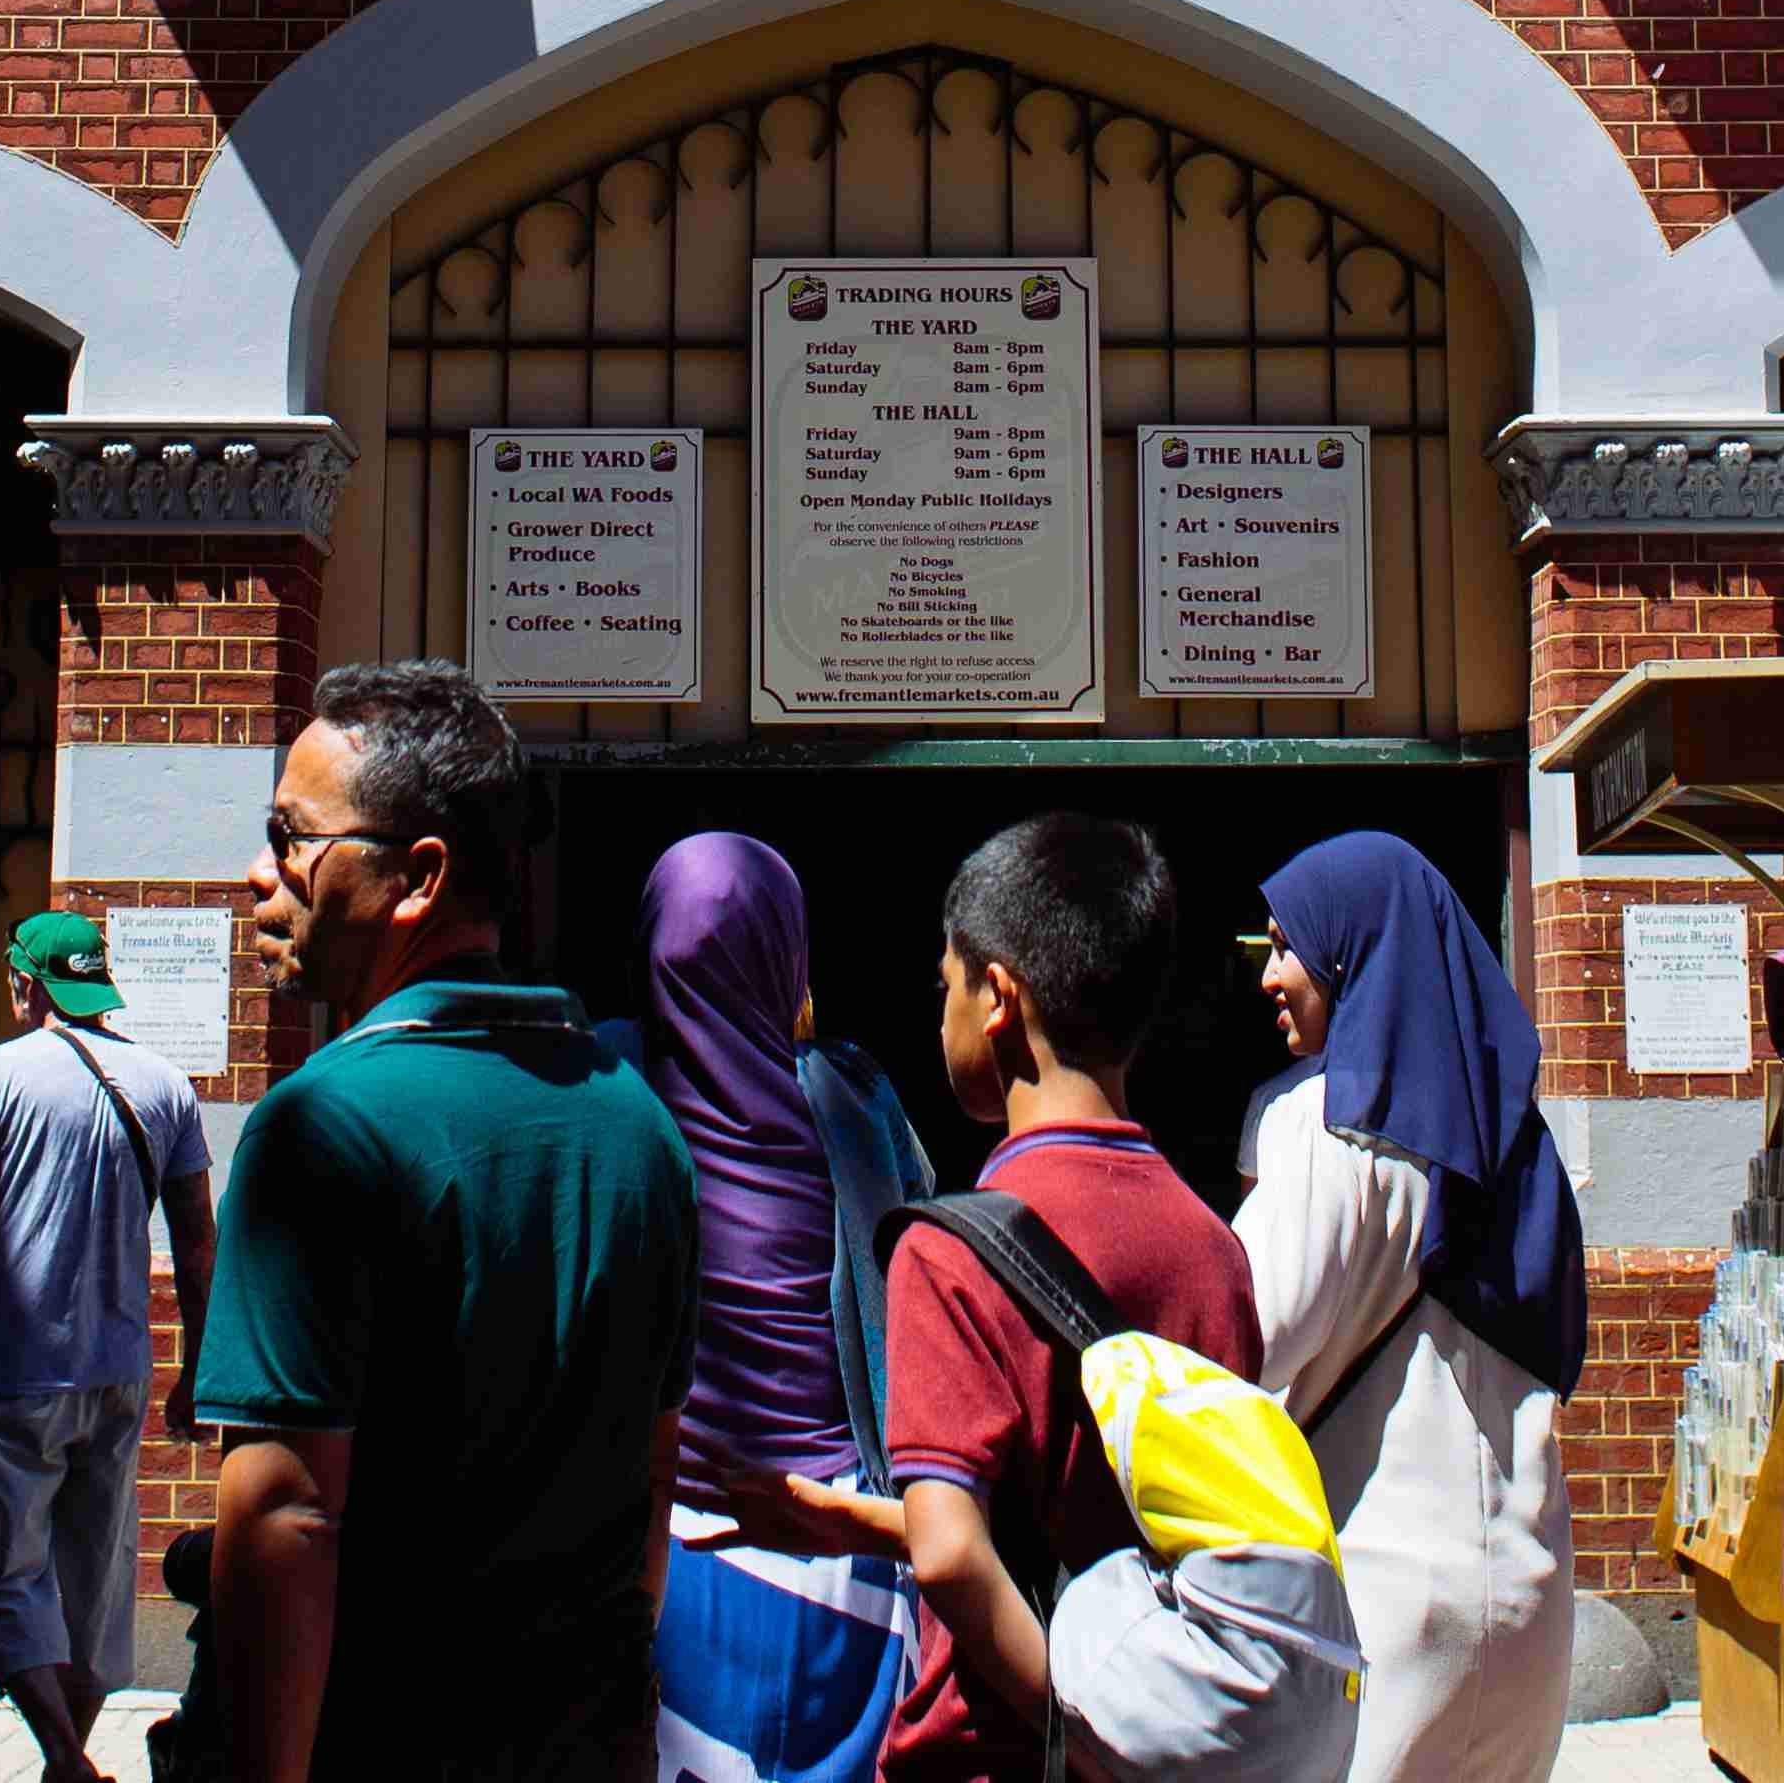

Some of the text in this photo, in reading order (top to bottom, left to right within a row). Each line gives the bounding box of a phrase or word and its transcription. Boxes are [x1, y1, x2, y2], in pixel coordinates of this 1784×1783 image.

[835, 288, 1013, 303] TRADING HOURS
[871, 320, 977, 336] THE YARD
[806, 342, 1044, 358] Friday 8am 8pm
[805, 361, 1044, 378] Saturday 8am 6pm
[805, 380, 1045, 397] Sunday 8am 6pm
[872, 405, 979, 421] THE HALL
[806, 427, 1045, 444] Friday 9am 8pm
[526, 450, 645, 468] THE YARD
[805, 446, 1046, 464] Saturday 9am 6pm
[1194, 447, 1312, 465] THE HALL
[805, 466, 1045, 483] Sunday 9am 6pm
[509, 487, 674, 503] Local WA Foods
[800, 493, 1052, 510] Open Monday Public Holidays
[1177, 483, 1283, 504] Designers
[507, 520, 654, 538] Grower Direct
[814, 520, 1040, 533] For the convenience of others PLEASE
[1176, 518, 1340, 534] Art Souvenirs
[829, 534, 1024, 550] observe the following restrictions
[509, 546, 595, 562] Produce
[1178, 552, 1259, 569] Fashion
[900, 556, 954, 570] No Dogs
[890, 571, 964, 585] No Bicycles
[505, 580, 641, 597] Arts Books
[889, 586, 967, 599] No Smoking
[1177, 586, 1261, 603] General
[877, 601, 977, 614] No Bill Sticking
[506, 615, 682, 636] Coffee Seating
[841, 616, 1013, 627] No Skateboards or the like
[1180, 610, 1315, 627] Merchandise
[841, 630, 1014, 642] No Rollerblades or the like
[818, 656, 1035, 670] We reserve the right to refuse access
[1185, 645, 1322, 666] Dining Bar
[795, 688, 1059, 702] www.fremantlemarkets.com.au
